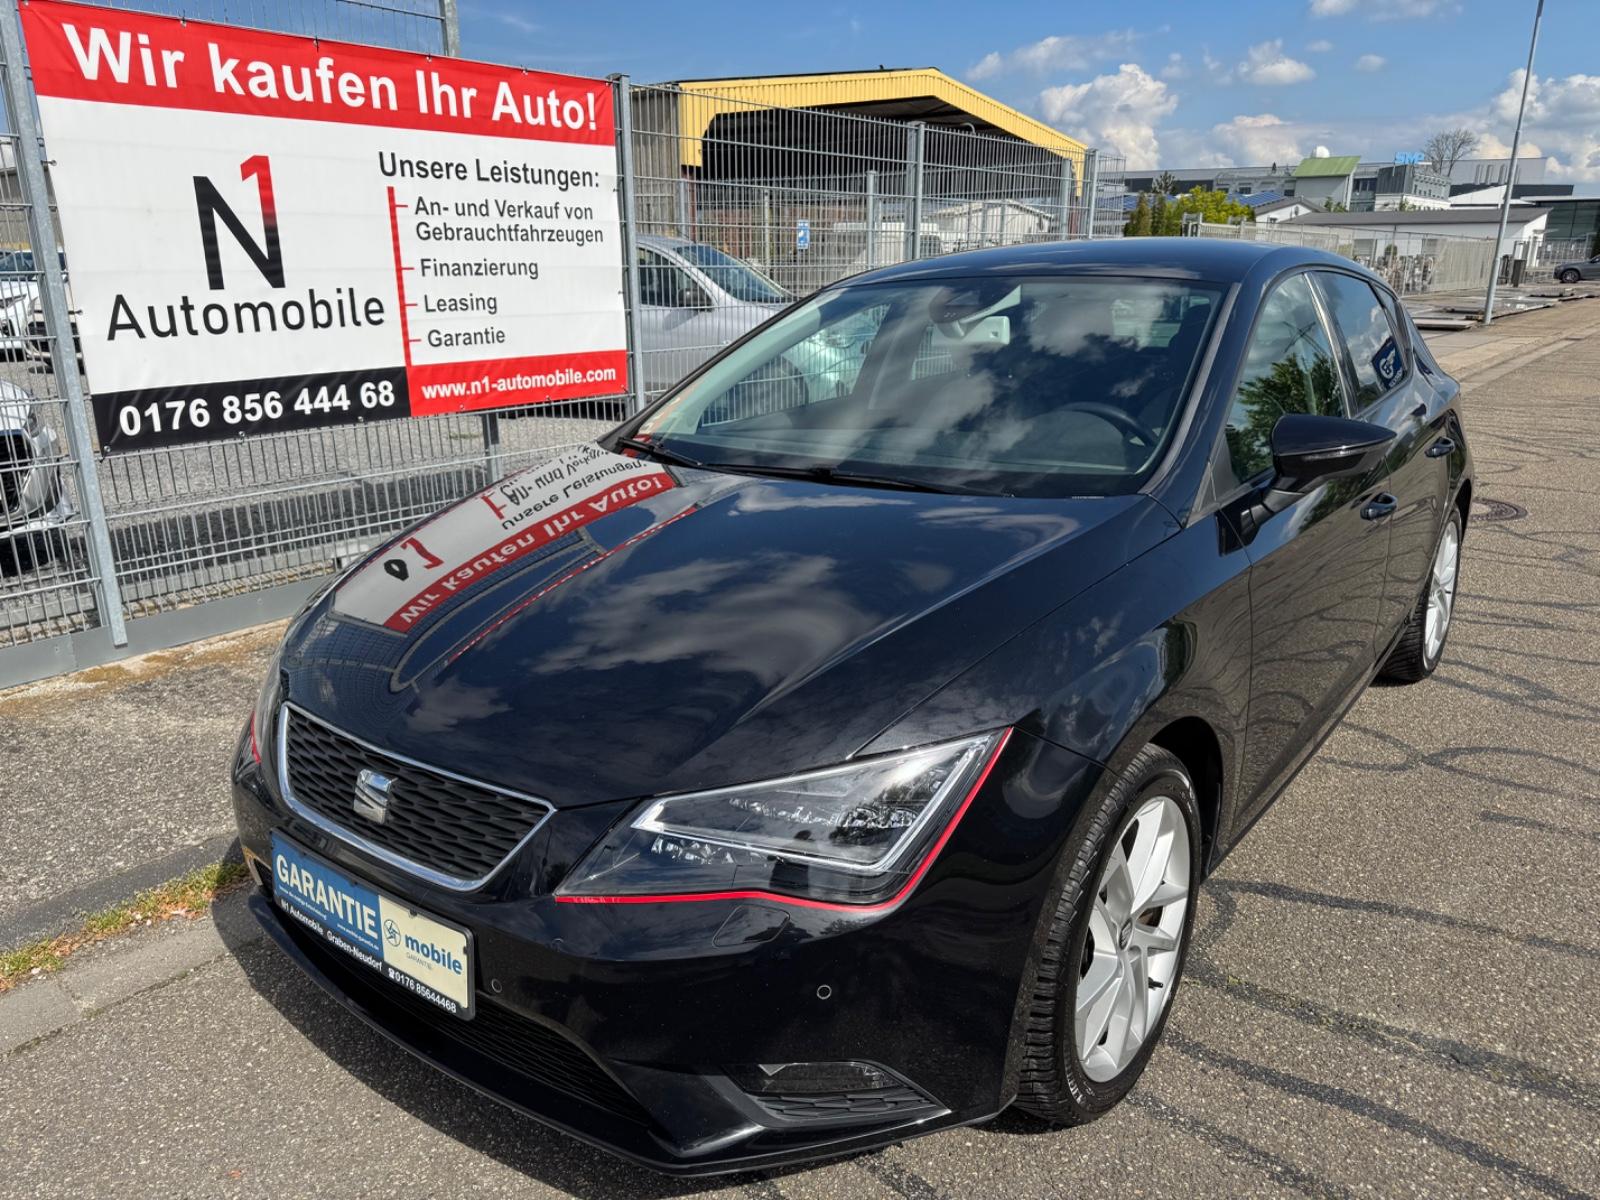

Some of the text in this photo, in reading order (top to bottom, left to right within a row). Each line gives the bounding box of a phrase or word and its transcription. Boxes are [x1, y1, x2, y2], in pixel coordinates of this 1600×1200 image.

[61, 23, 597, 131] Wir kaufen Ihr Auto!
[379, 151, 600, 192] Unsere Leistungen:
[193, 155, 286, 290] N1
[415, 196, 594, 220] An- und Verkauf von
[416, 221, 604, 247] Gebrauchtfahrzeugen
[420, 258, 539, 280] Finanzierung
[107, 287, 385, 341] Automobile
[424, 293, 498, 315] Leasing
[427, 326, 506, 348] Garantie
[421, 367, 616, 399] www.n1-automobile.com
[119, 380, 395, 436] 0176 856 444 68
[276, 853, 379, 940] GARANTIE
[326, 930, 382, 972] Graben-Neudorf
[405, 934, 463, 976] mobile
[395, 971, 415, 991] 0176
